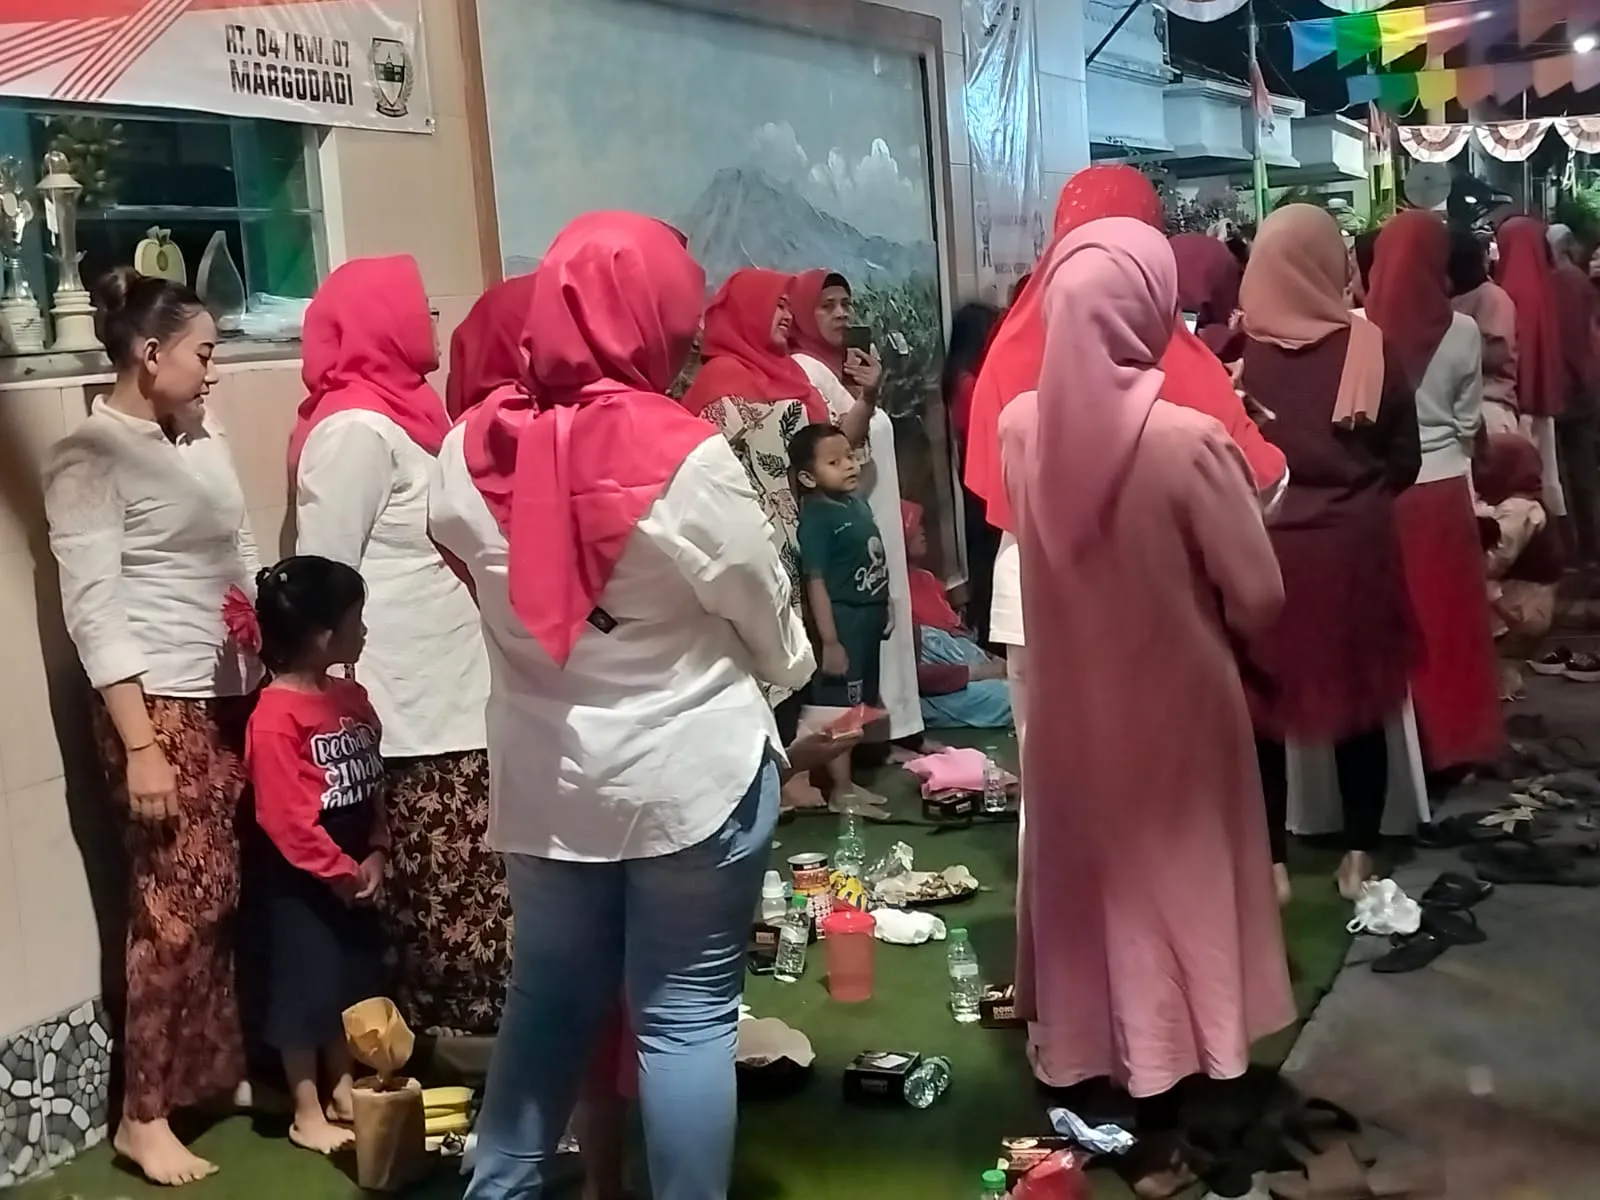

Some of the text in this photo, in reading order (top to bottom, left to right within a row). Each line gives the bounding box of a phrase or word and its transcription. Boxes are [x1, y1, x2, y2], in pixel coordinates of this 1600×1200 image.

[225, 24, 252, 55] RT.
[256, 28, 280, 59] 04
[294, 33, 329, 65] RW.
[333, 39, 349, 68] 07
[229, 59, 354, 106] MARGODADI
